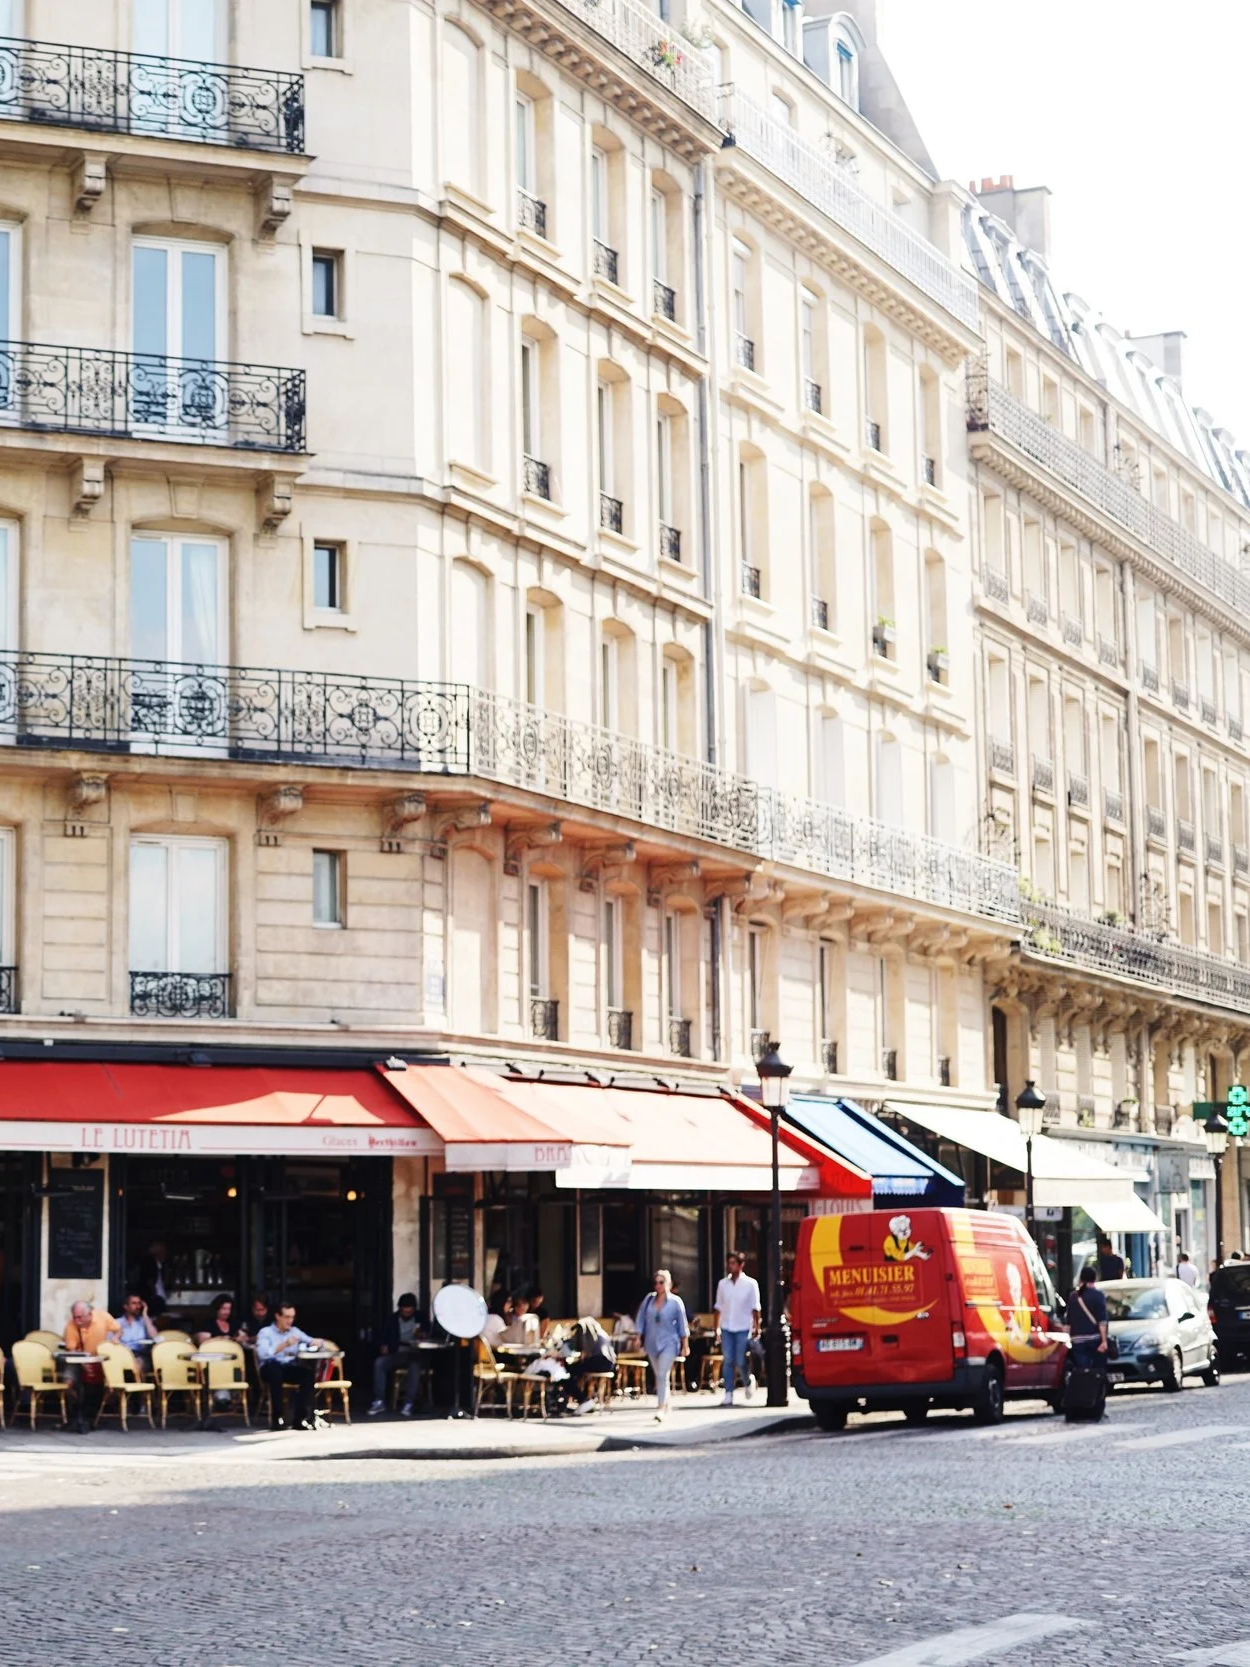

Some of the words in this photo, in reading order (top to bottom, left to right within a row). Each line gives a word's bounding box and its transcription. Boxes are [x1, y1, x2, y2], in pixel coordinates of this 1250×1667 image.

[81, 1127, 104, 1148] LE
[113, 1127, 192, 1150] LUTETIA
[828, 1265, 916, 1287] MENUISIER
